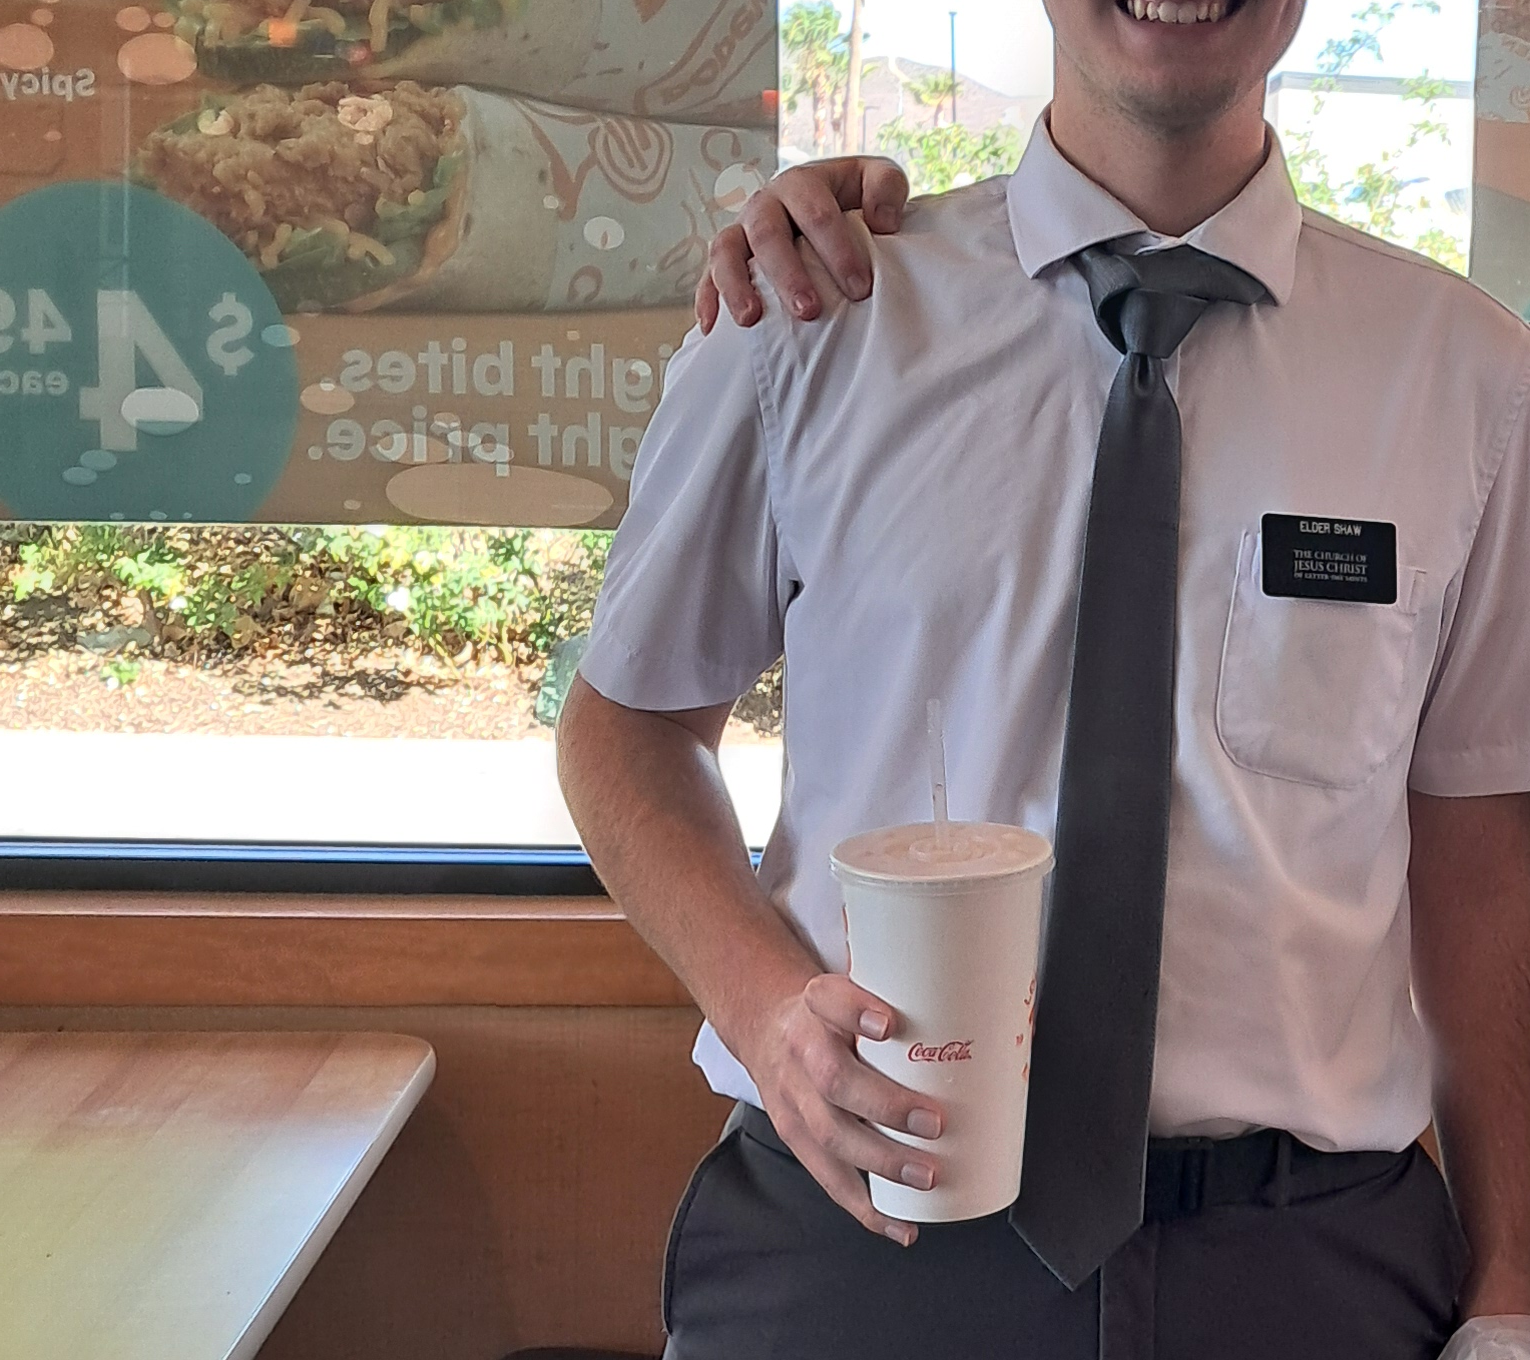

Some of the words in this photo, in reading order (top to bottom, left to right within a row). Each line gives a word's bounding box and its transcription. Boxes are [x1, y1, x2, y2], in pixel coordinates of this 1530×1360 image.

[1300, 520, 1330, 534] ELDER
[1333, 522, 1362, 536] SHAW
[1293, 549, 1312, 559] THE
[1314, 550, 1353, 561] CHURCH
[1294, 559, 1324, 573] JESUS
[1326, 562, 1368, 575] CHRIST
